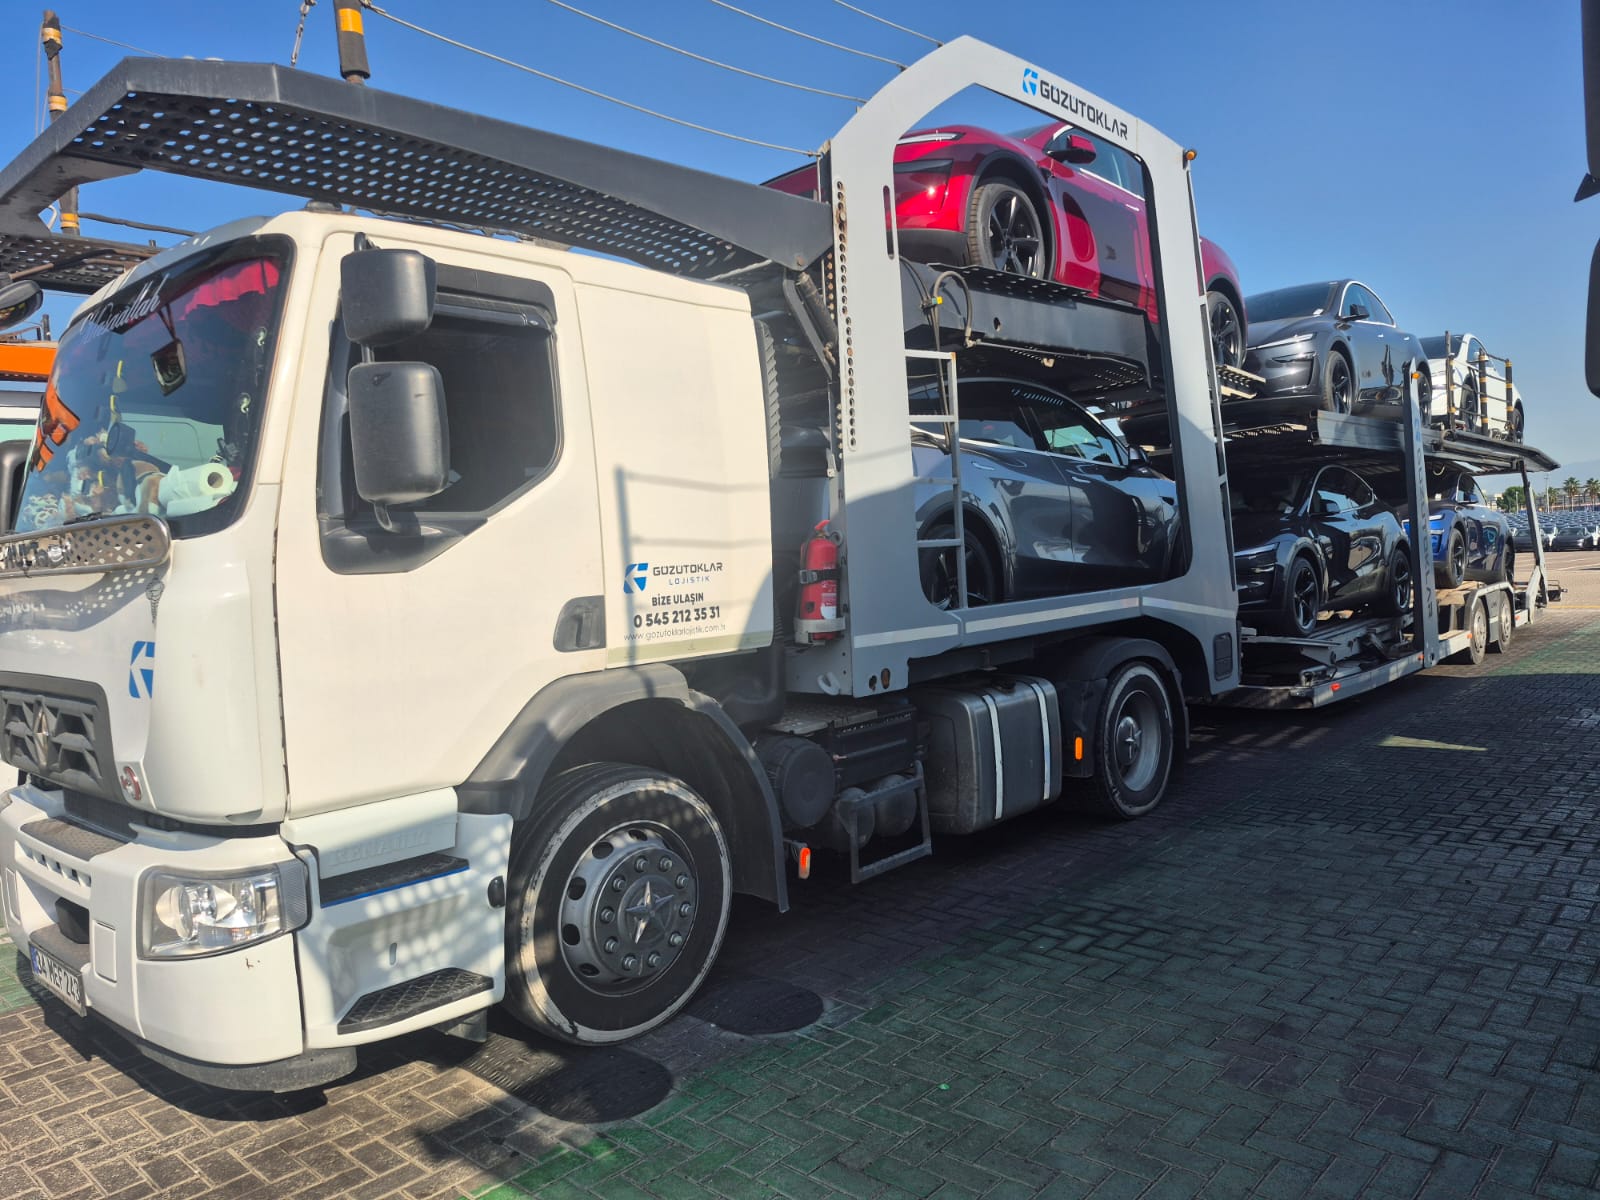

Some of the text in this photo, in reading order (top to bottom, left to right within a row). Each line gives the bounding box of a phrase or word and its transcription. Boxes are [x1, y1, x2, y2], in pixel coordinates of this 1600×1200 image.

[651, 592, 704, 606] BİZE ULAŞIN
[633, 606, 721, 628] 0 545 212 35 31
